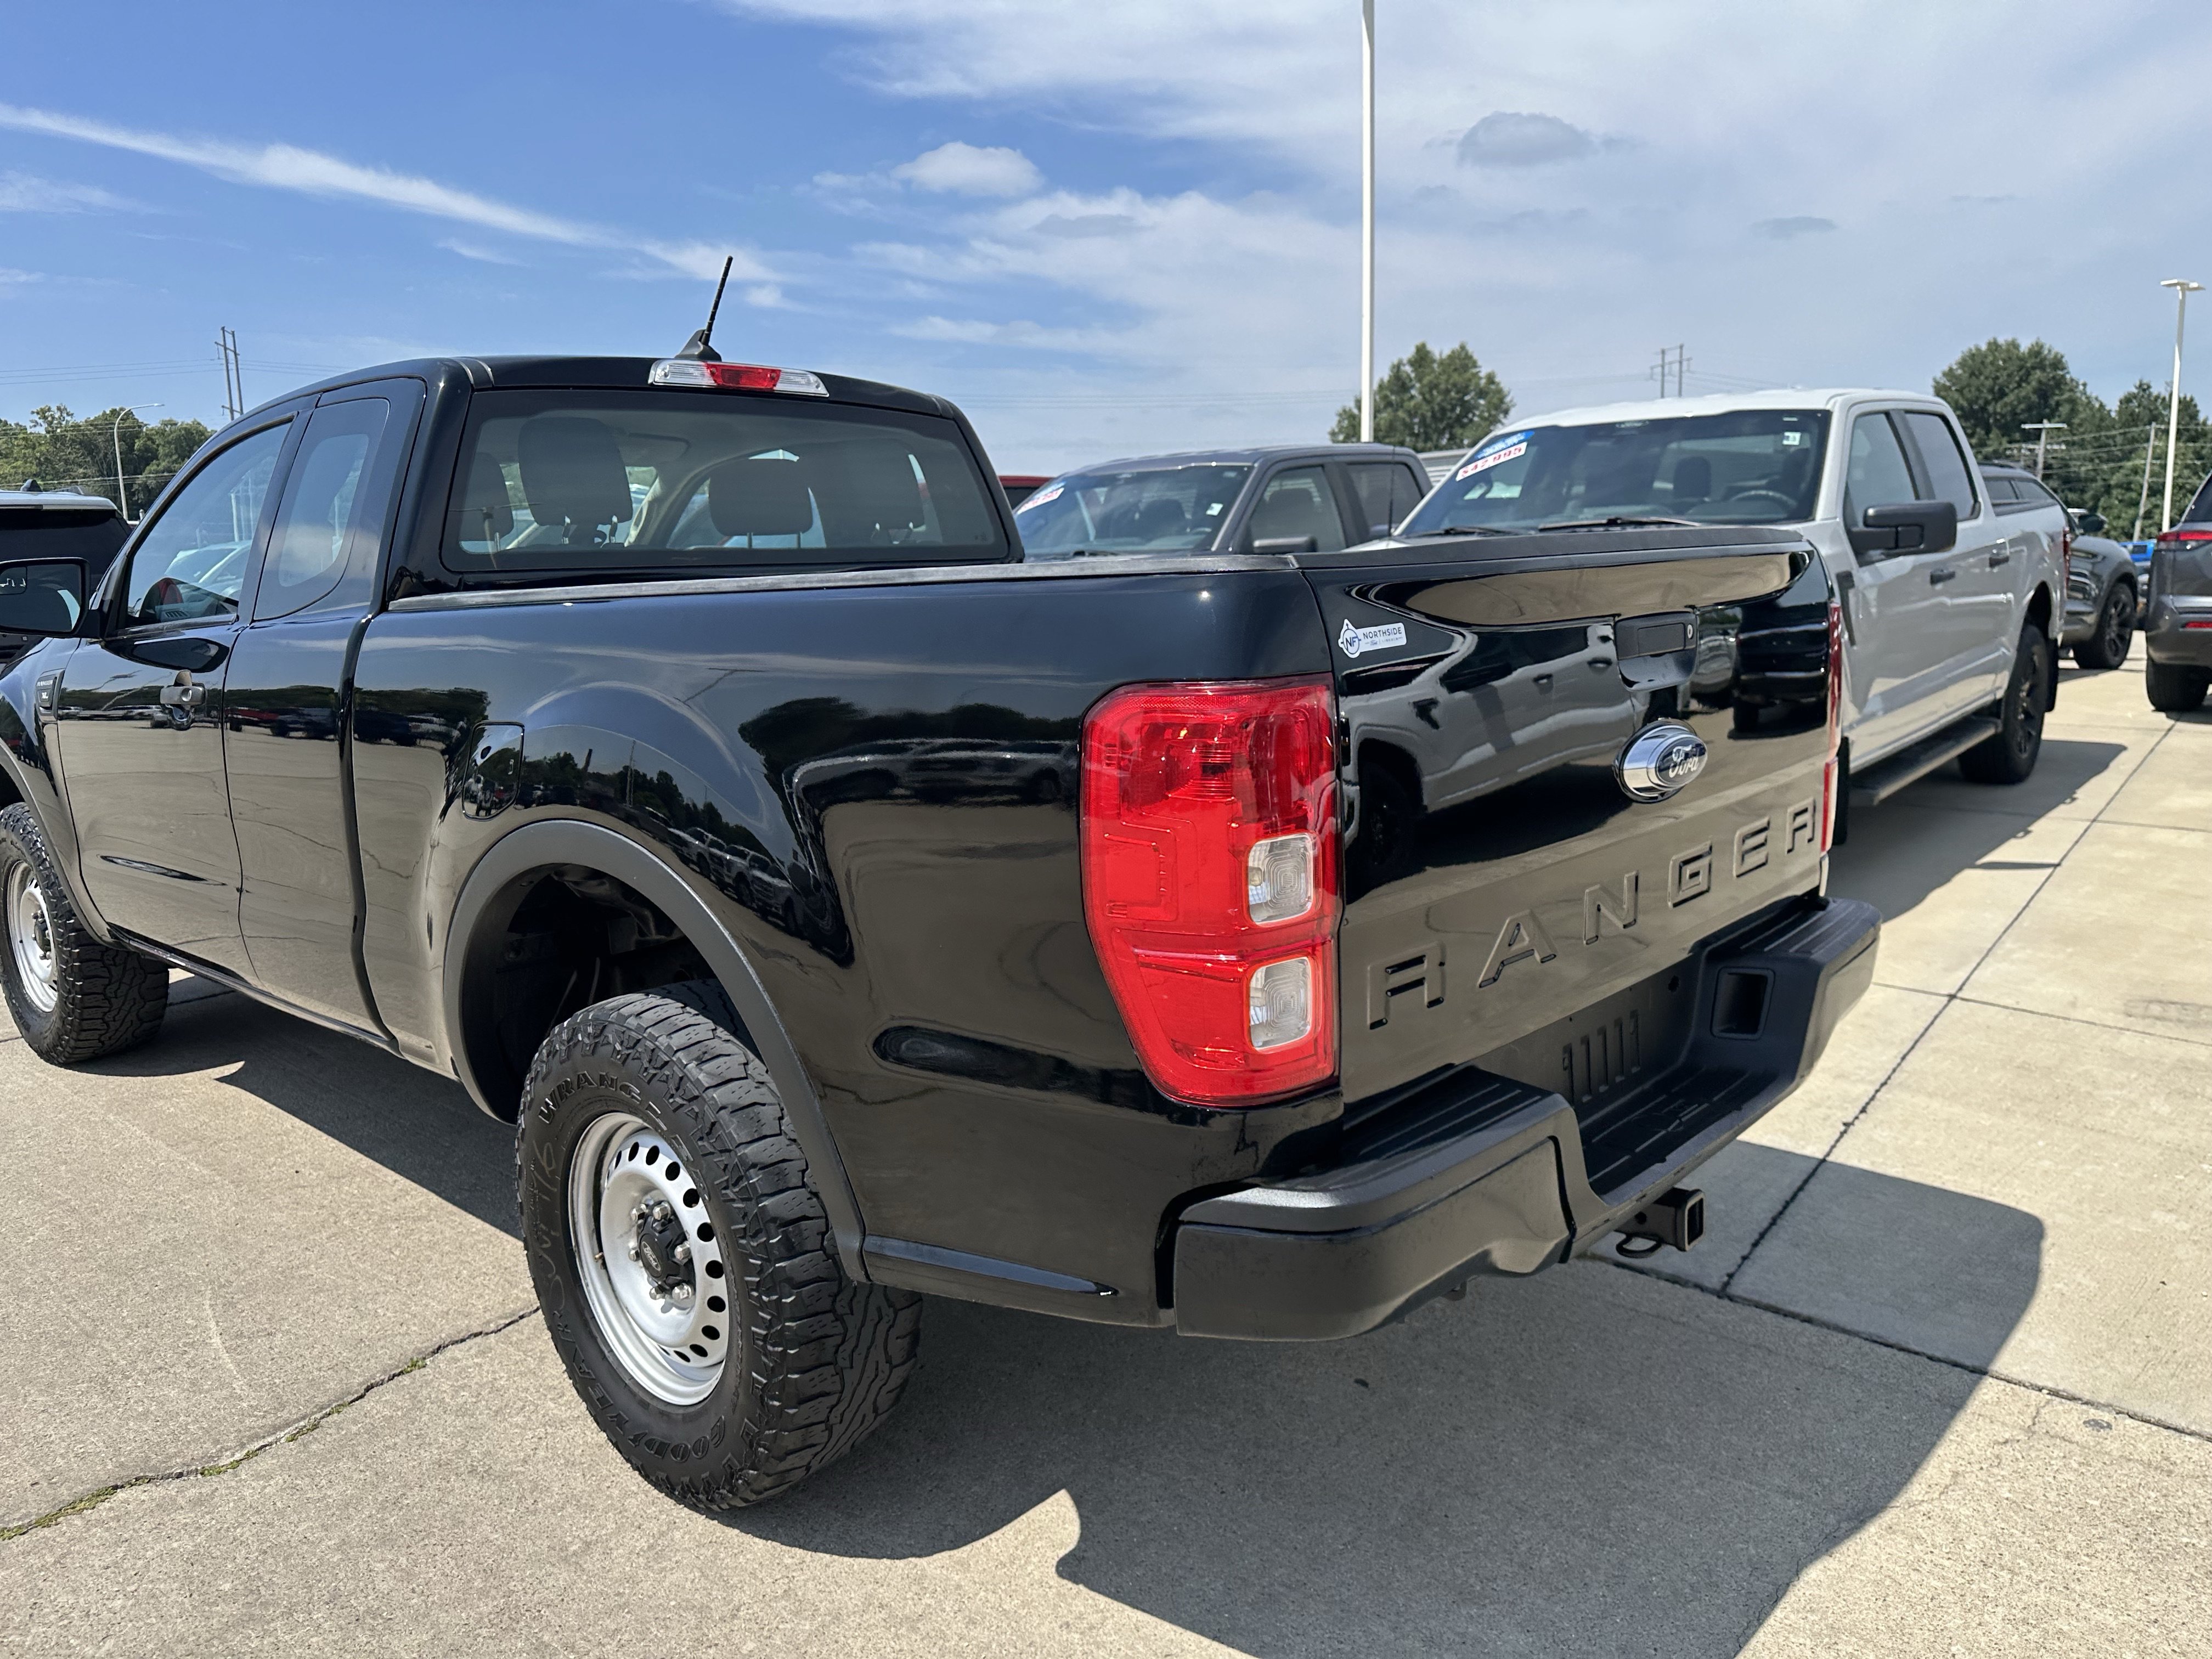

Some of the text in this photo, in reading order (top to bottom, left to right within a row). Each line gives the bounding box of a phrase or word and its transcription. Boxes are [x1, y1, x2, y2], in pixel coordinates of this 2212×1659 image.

[1345, 636, 1358, 651] NF
[1363, 627, 1402, 640] NORTHSIDE
[1668, 744, 1699, 778] Ford
[1367, 797, 1817, 1030] RANGER
[538, 1070, 711, 1203] WRANGLER
[553, 1309, 726, 1463] GOODYEAR
